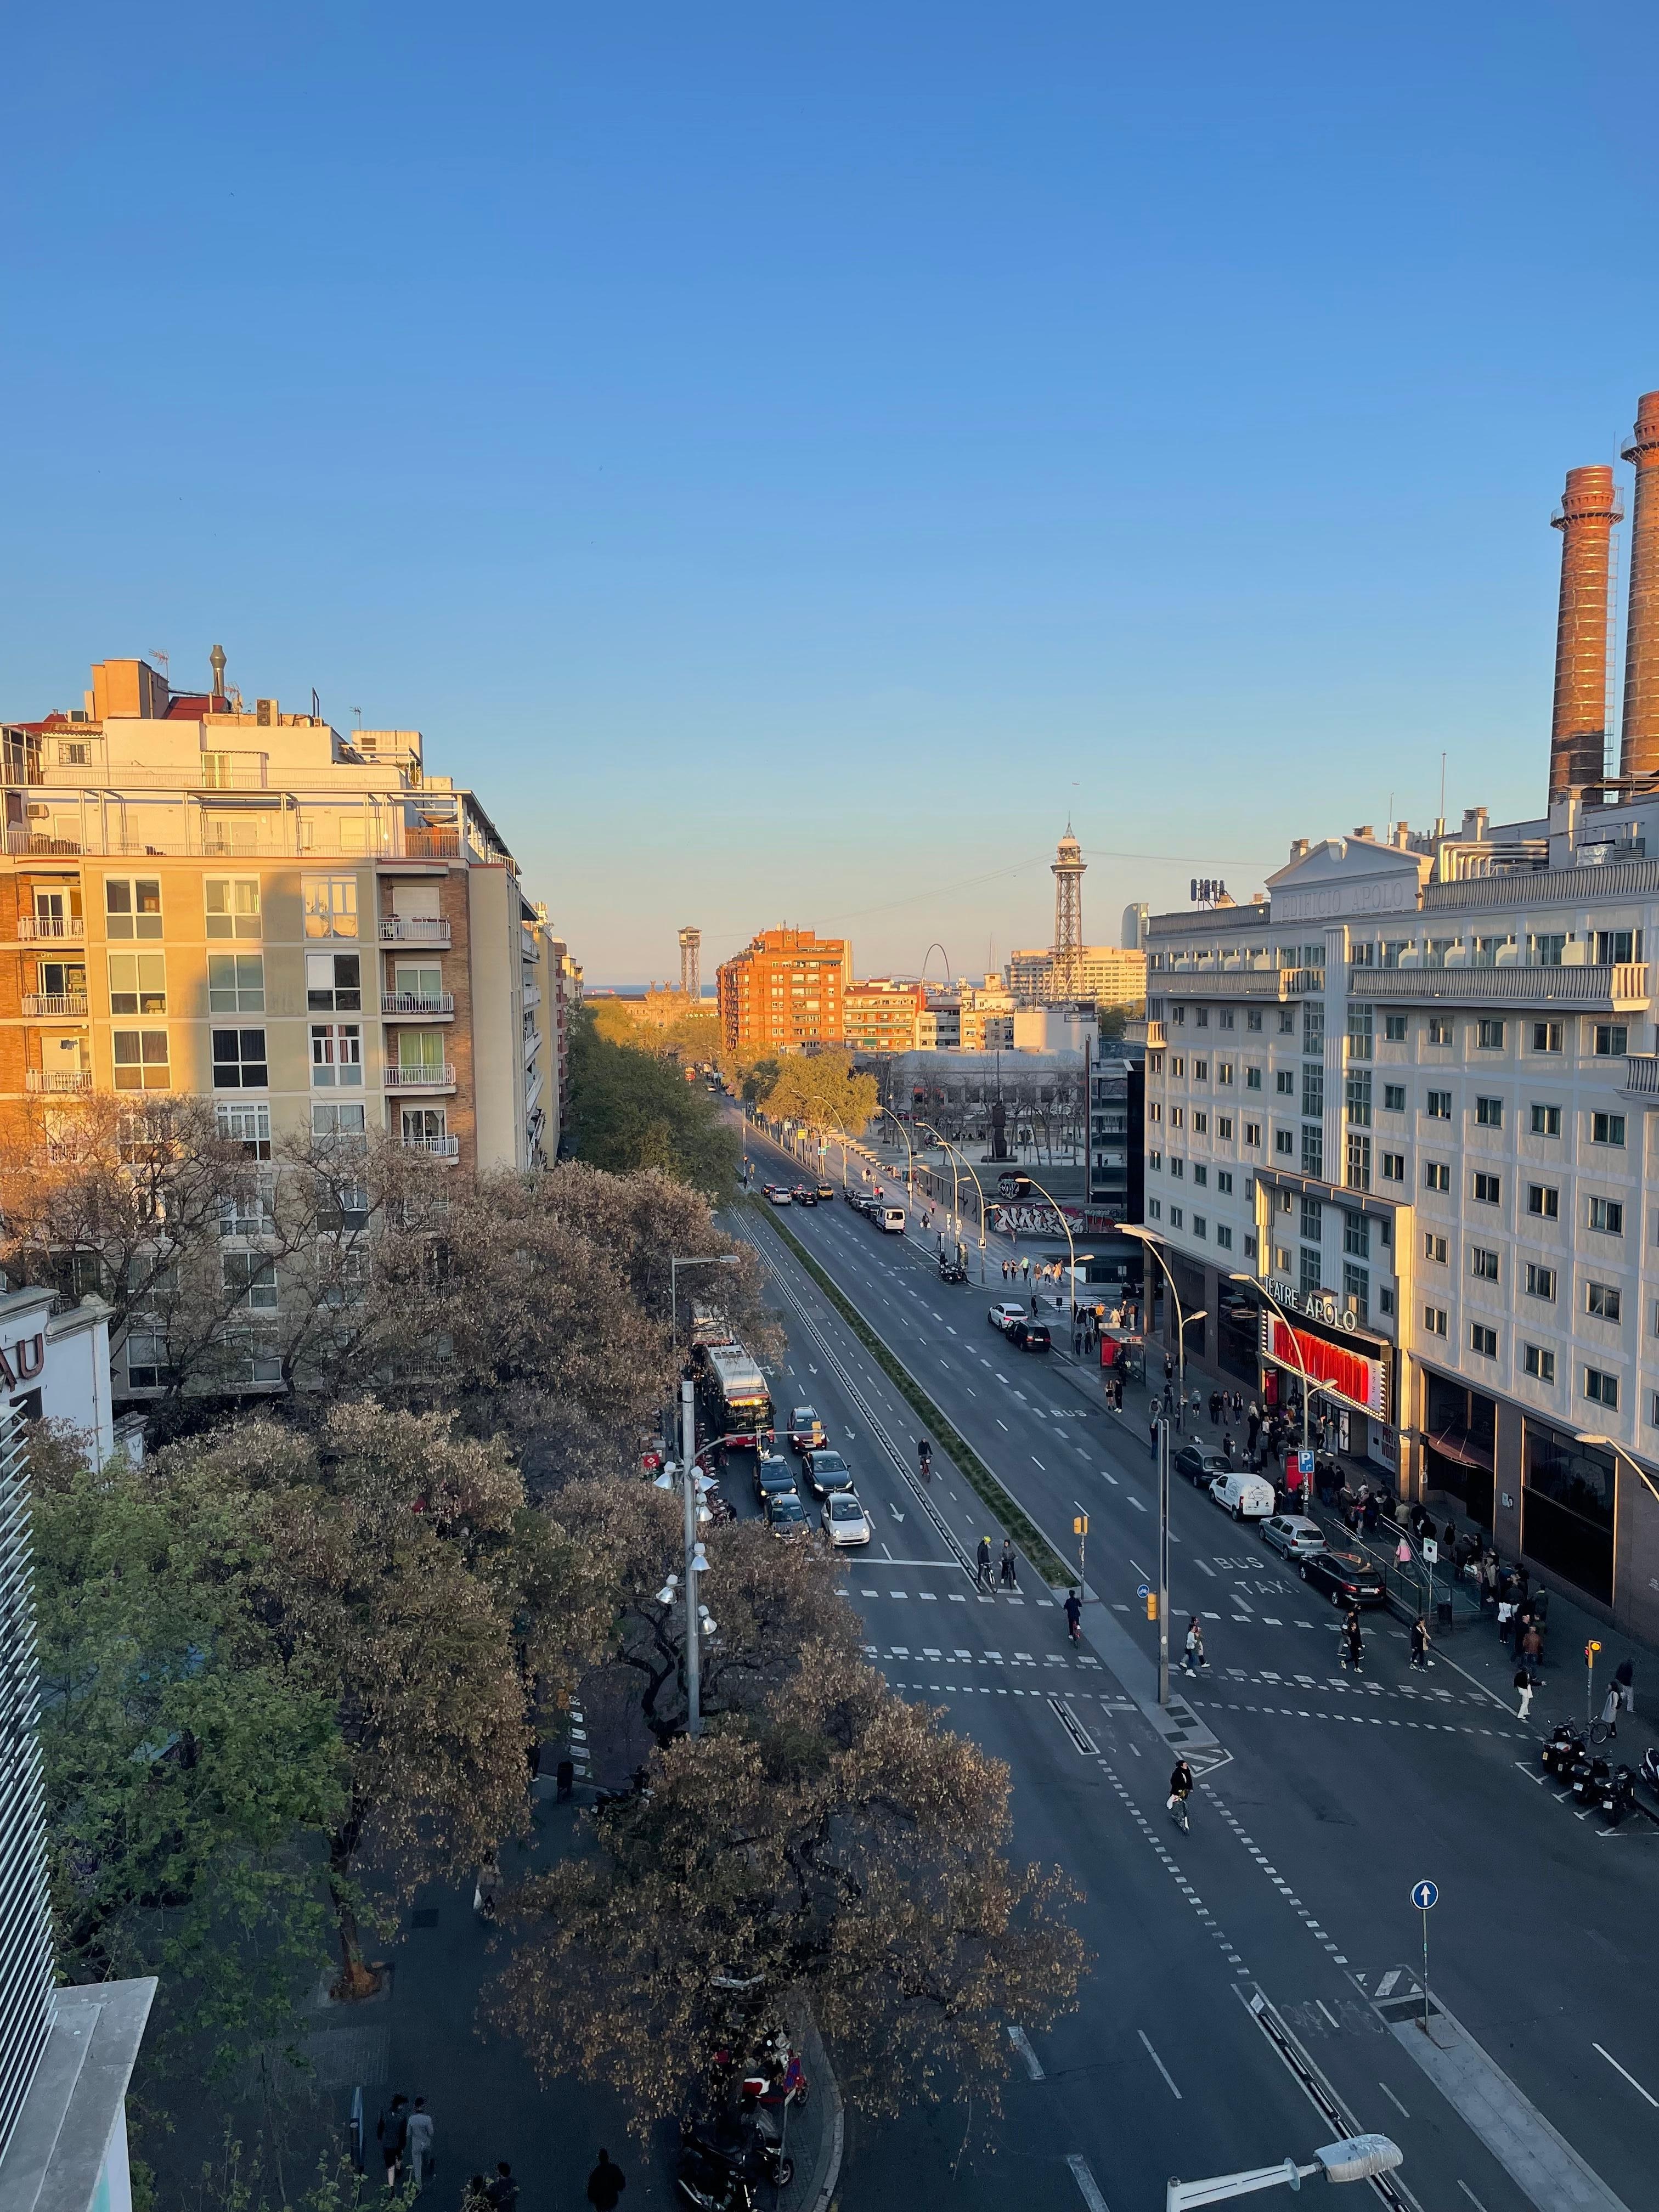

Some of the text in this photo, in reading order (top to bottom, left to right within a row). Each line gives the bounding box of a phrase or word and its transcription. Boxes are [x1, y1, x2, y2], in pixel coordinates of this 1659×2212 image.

[1282, 882, 1403, 918] EDIFICIO APOLO
[1265, 1273, 1299, 1310] TEATRE
[1301, 1452, 1311, 1464] P
[1212, 1556, 1265, 1570] BUS
[1234, 1580, 1300, 1594] TAXI
